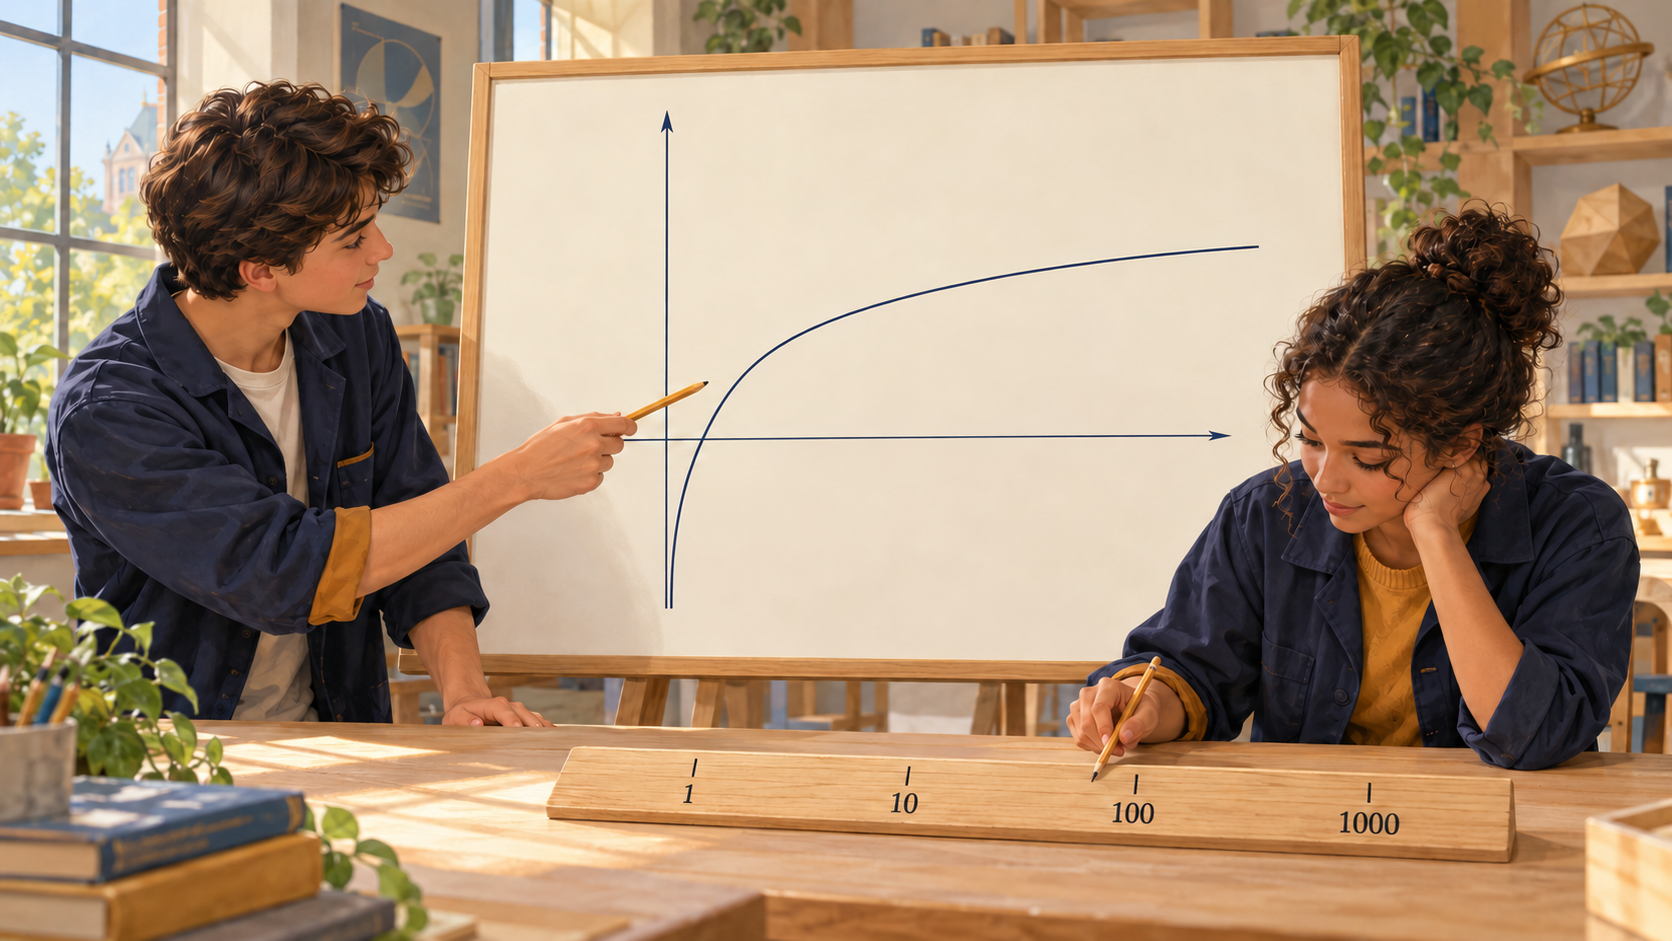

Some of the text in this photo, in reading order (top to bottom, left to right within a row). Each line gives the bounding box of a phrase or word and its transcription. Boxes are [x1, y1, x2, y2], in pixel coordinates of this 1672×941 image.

[683, 784, 1400, 836] 1 10 100 1000
